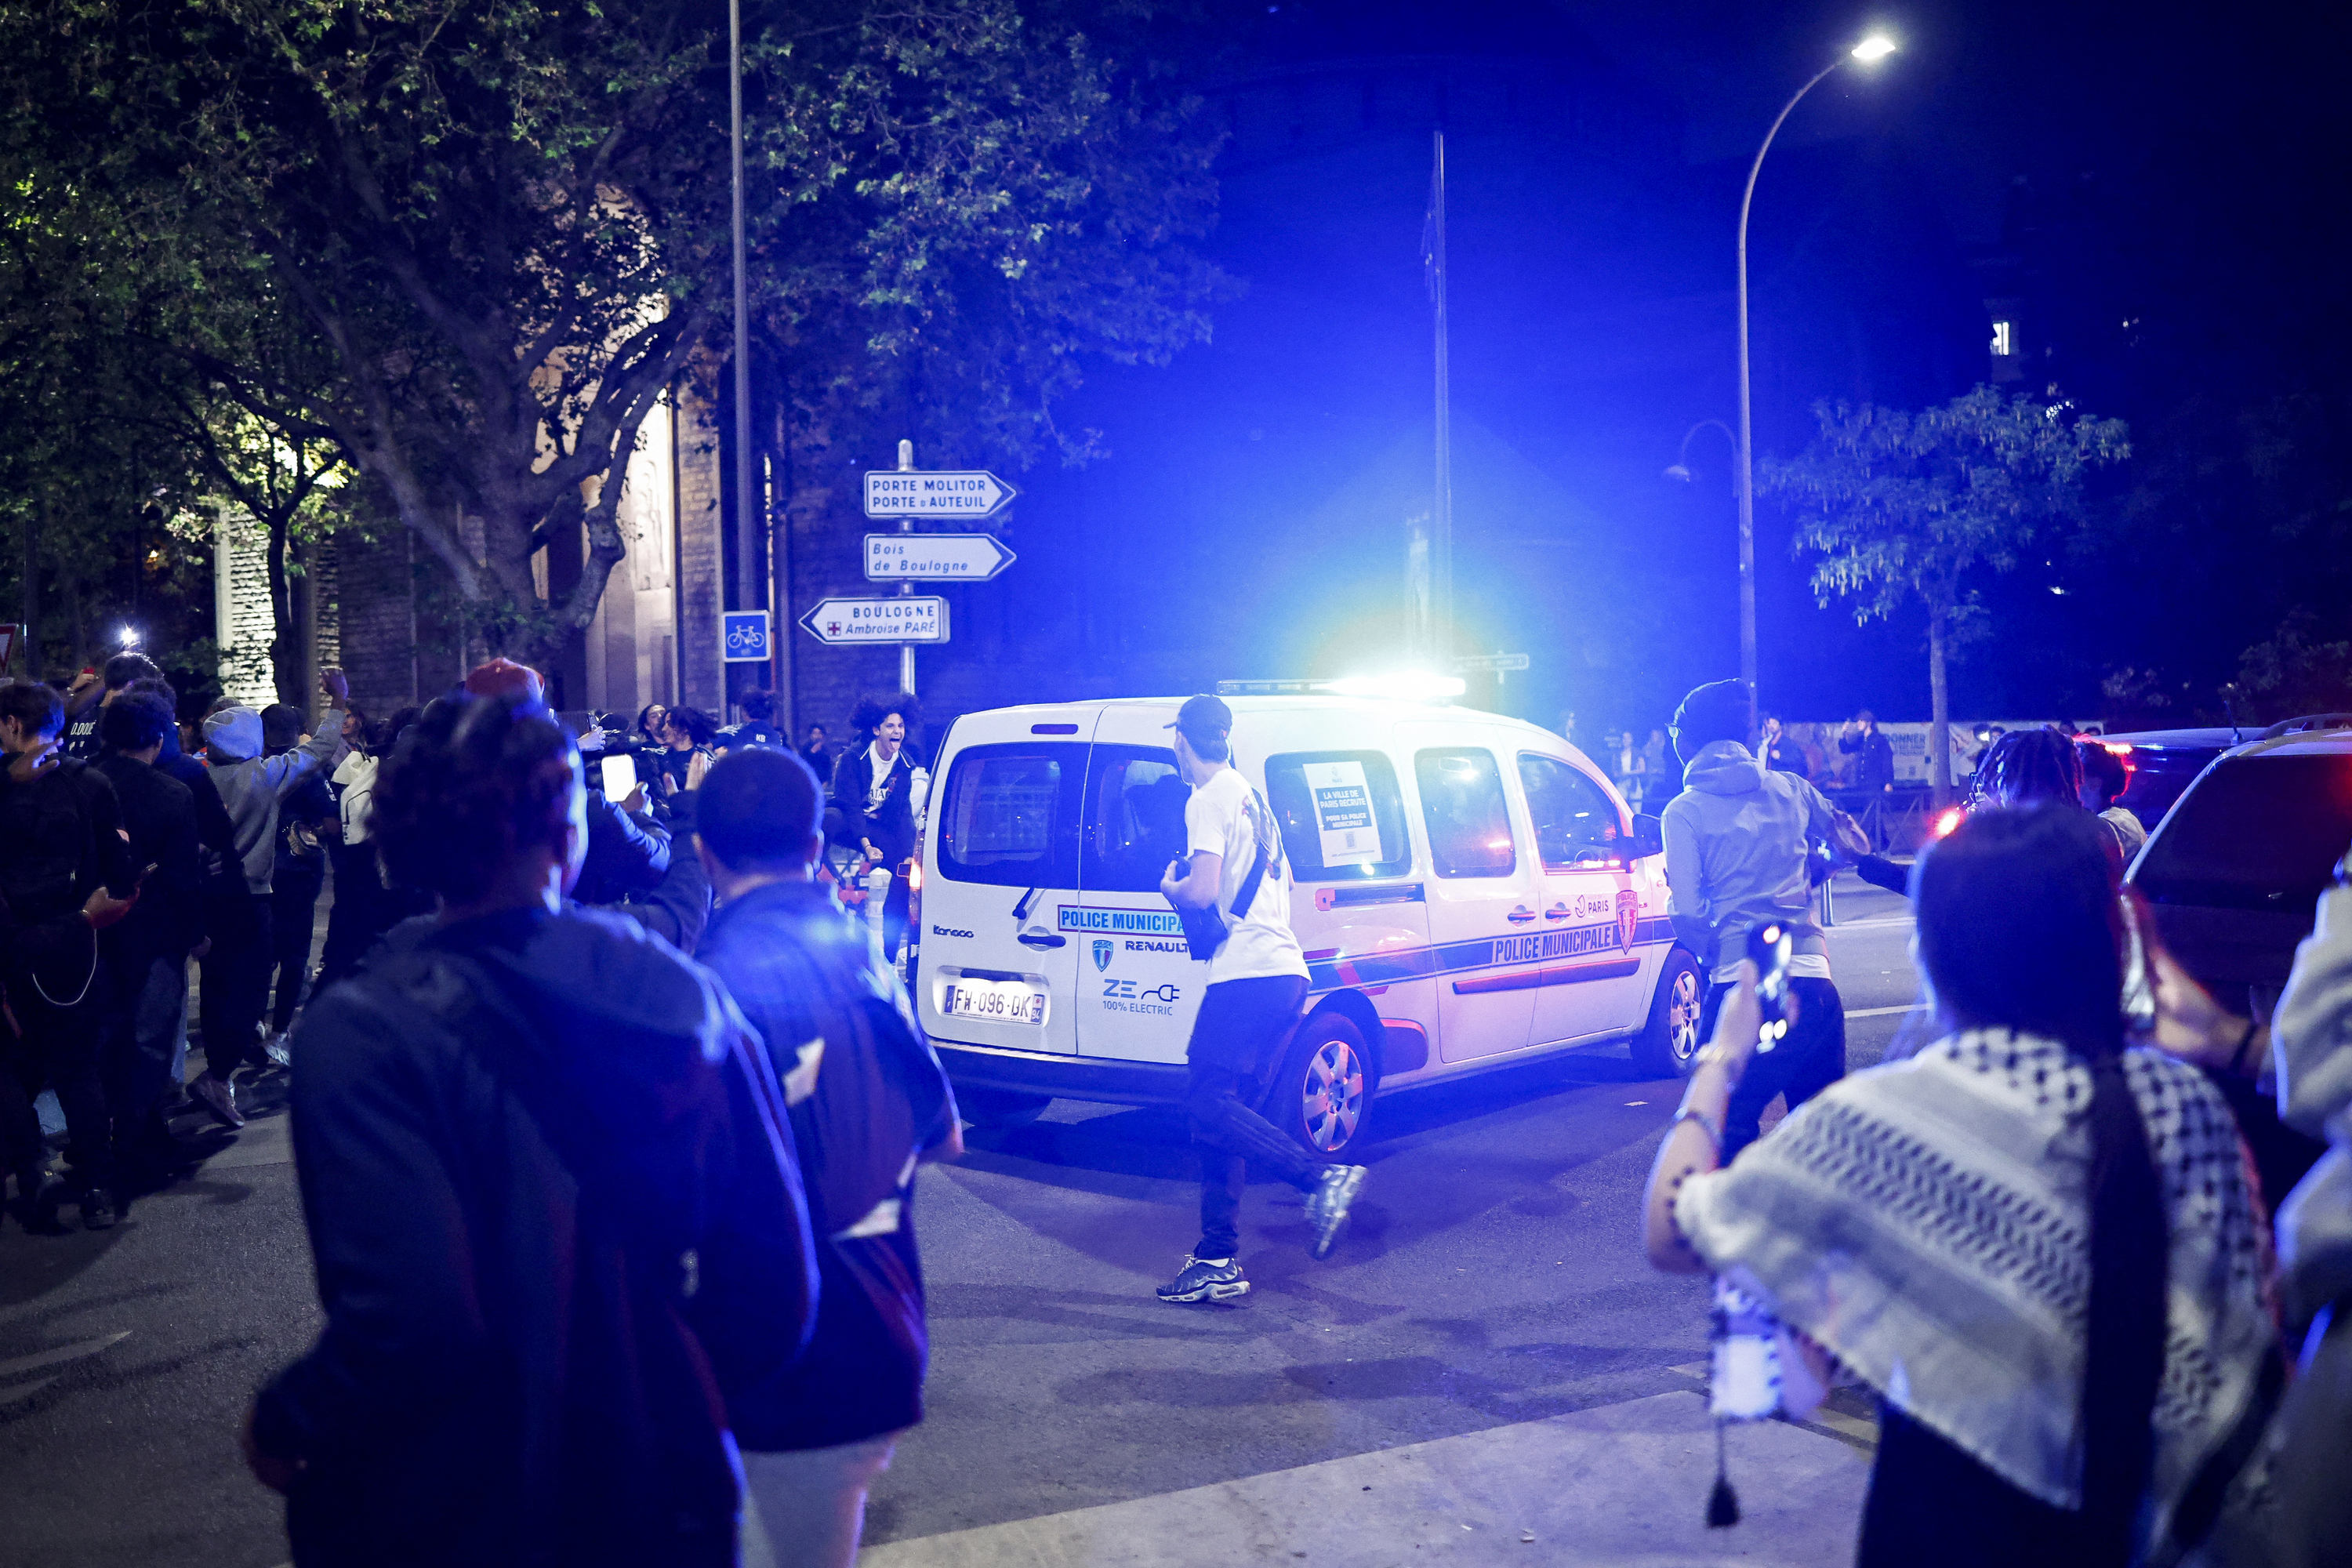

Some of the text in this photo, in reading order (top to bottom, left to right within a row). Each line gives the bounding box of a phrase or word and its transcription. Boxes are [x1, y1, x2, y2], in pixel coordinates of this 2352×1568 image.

[873, 480, 985, 491] PORTE MOLITOR
[873, 496, 916, 507] PORTE
[873, 543, 904, 554] Bois
[874, 560, 967, 573] de Boulogne
[853, 605, 934, 618] BOULOGNE
[845, 619, 935, 634] Ambroise PARÉ
[1319, 798, 1366, 808] PARIS RECRUTE
[1588, 900, 1609, 913] PARIS
[1062, 910, 1185, 931] POLICE MUNICIPA
[1125, 941, 1189, 953] RENAULT
[1496, 925, 1610, 962] POLICE MUNICIPALE
[1103, 978, 1137, 999] ZE
[1103, 1000, 1173, 1015] 100% ELECTRIC
[1032, 1010, 1040, 1020] 94
